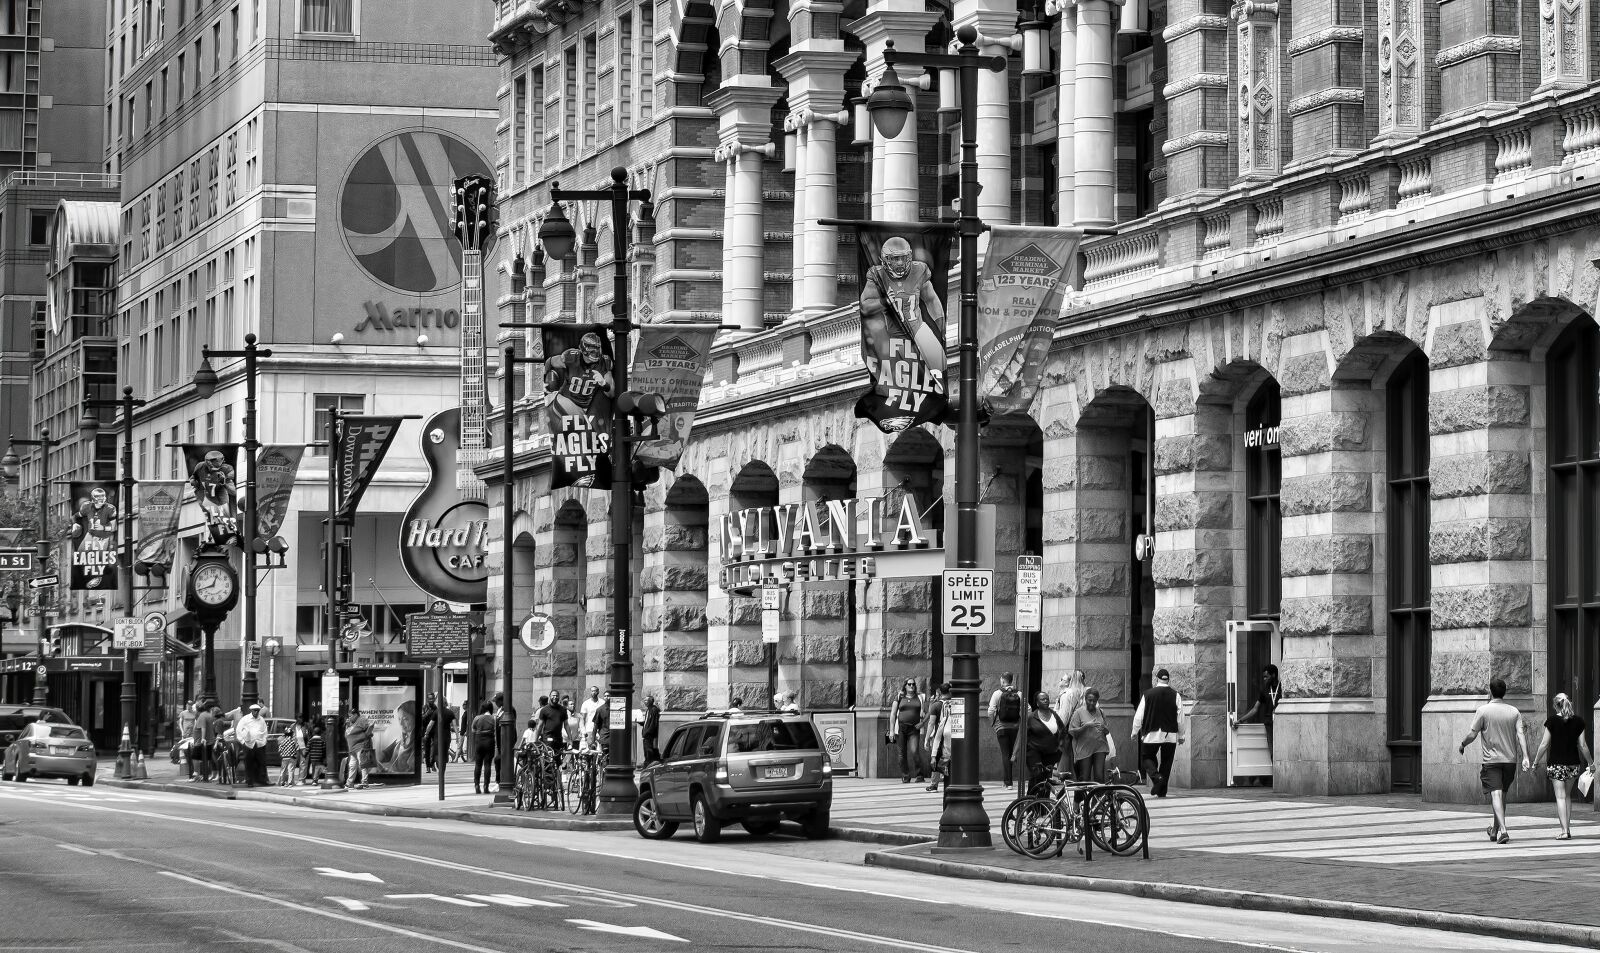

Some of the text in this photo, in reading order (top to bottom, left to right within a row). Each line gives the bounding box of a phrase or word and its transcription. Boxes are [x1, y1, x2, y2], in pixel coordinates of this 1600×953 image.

[997, 275, 1056, 288] 125 YEARS
[1012, 297, 1037, 306] REAL
[978, 307, 1000, 315] MOM
[1003, 308, 1010, 316] &
[1013, 308, 1034, 317] POP
[983, 333, 1025, 361] PHILADELPHIA
[665, 360, 696, 370] YEARS
[632, 377, 667, 385] PHILLY'S
[885, 388, 927, 413] FLY
[562, 415, 595, 431] FLY
[343, 425, 363, 498] Downtown
[564, 455, 597, 473] FLY
[407, 519, 473, 547] Hard
[84, 540, 105, 551] FLY
[12, 557, 24, 565] St
[73, 551, 117, 565] EAGLES
[1025, 557, 1035, 565] NO
[84, 565, 105, 576] FLY
[781, 557, 876, 578] CENTER
[947, 576, 989, 587] SPEED
[952, 590, 985, 601] LIMIT
[950, 605, 986, 628] 25
